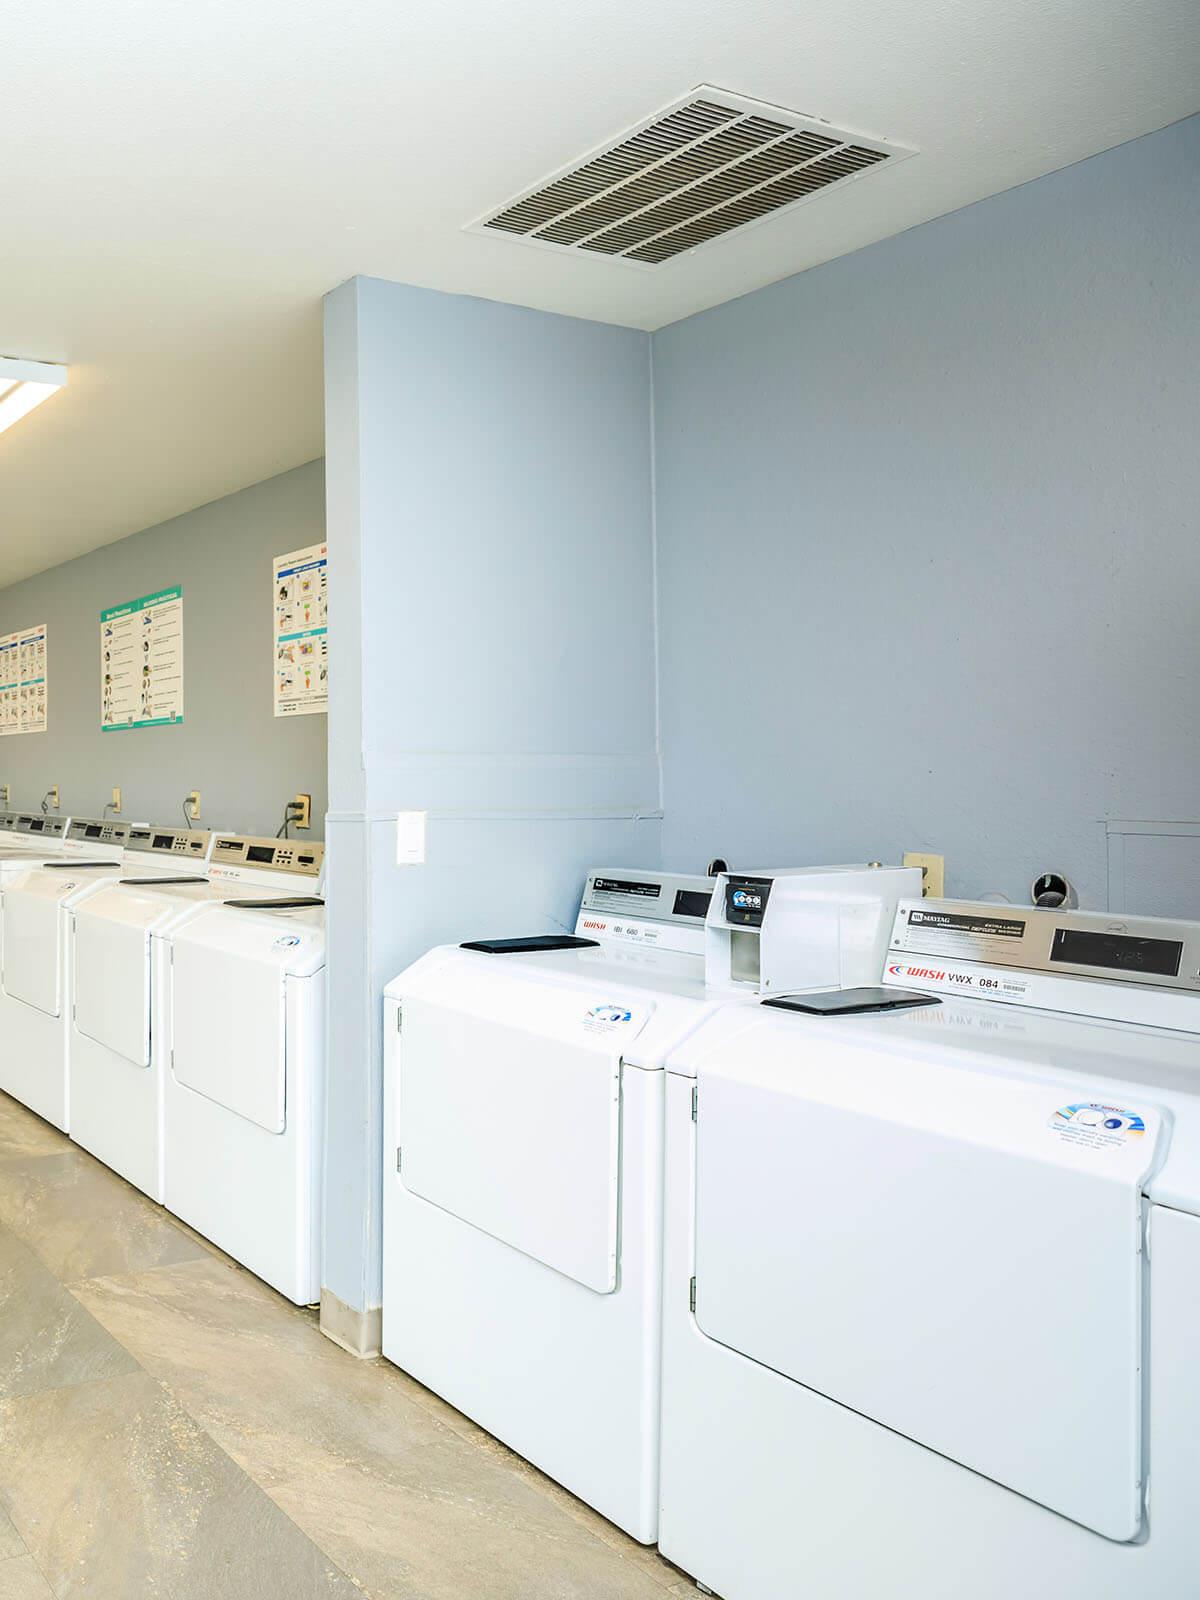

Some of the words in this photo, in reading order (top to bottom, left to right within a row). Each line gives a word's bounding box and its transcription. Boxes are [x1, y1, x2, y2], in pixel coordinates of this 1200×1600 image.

[923, 915, 950, 923] MAYTAG
[906, 967, 945, 980] WASH
[948, 973, 973, 985] VWX
[979, 978, 999, 989] 084
